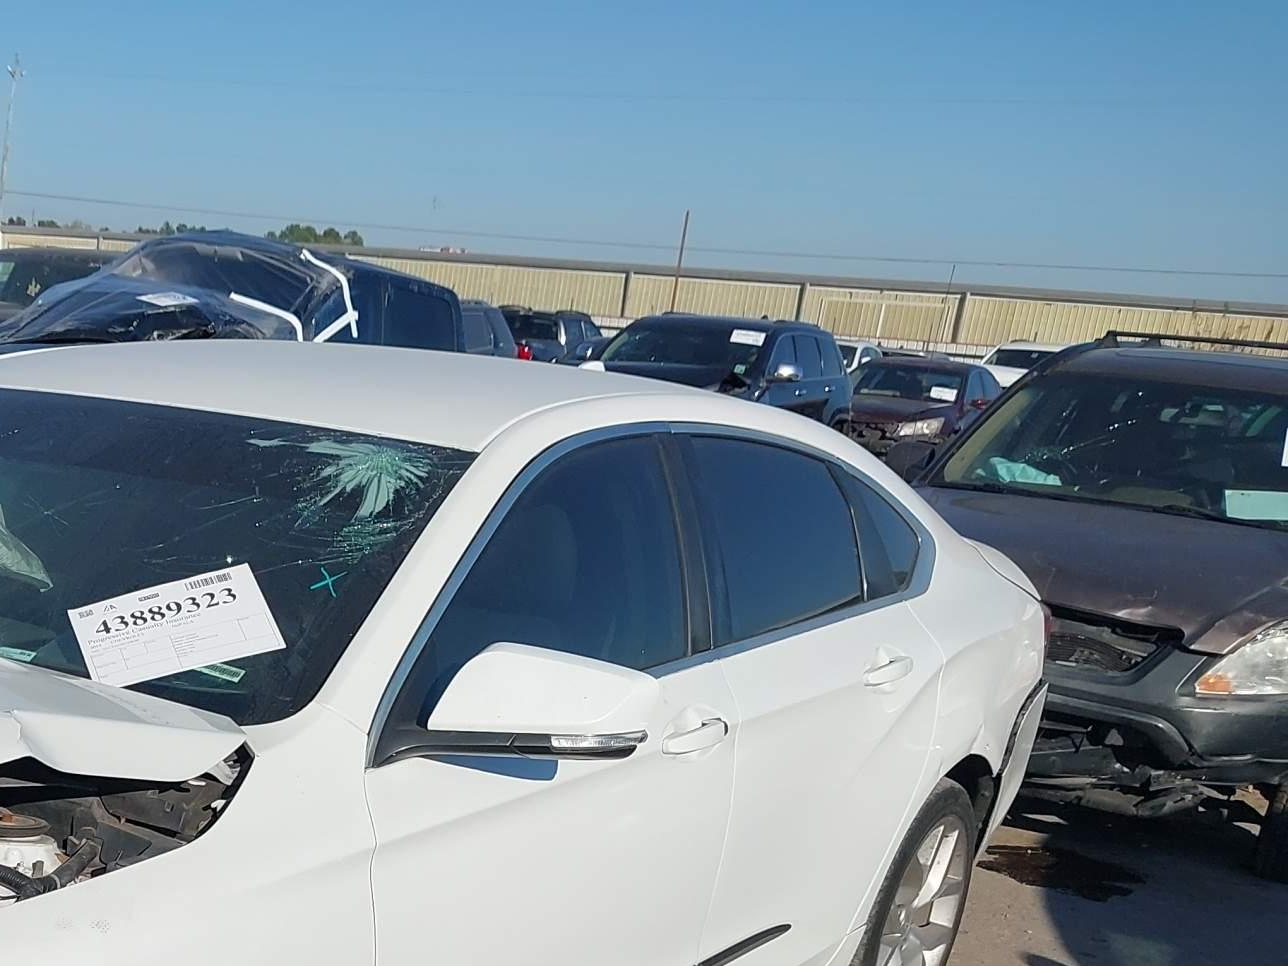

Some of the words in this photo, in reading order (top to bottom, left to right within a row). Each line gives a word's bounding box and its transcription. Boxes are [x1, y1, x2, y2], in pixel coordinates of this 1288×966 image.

[88, 631, 129, 645] Progressive
[131, 622, 164, 634] Casualty
[165, 612, 201, 625] Insurance
[95, 587, 237, 635] 43889323
